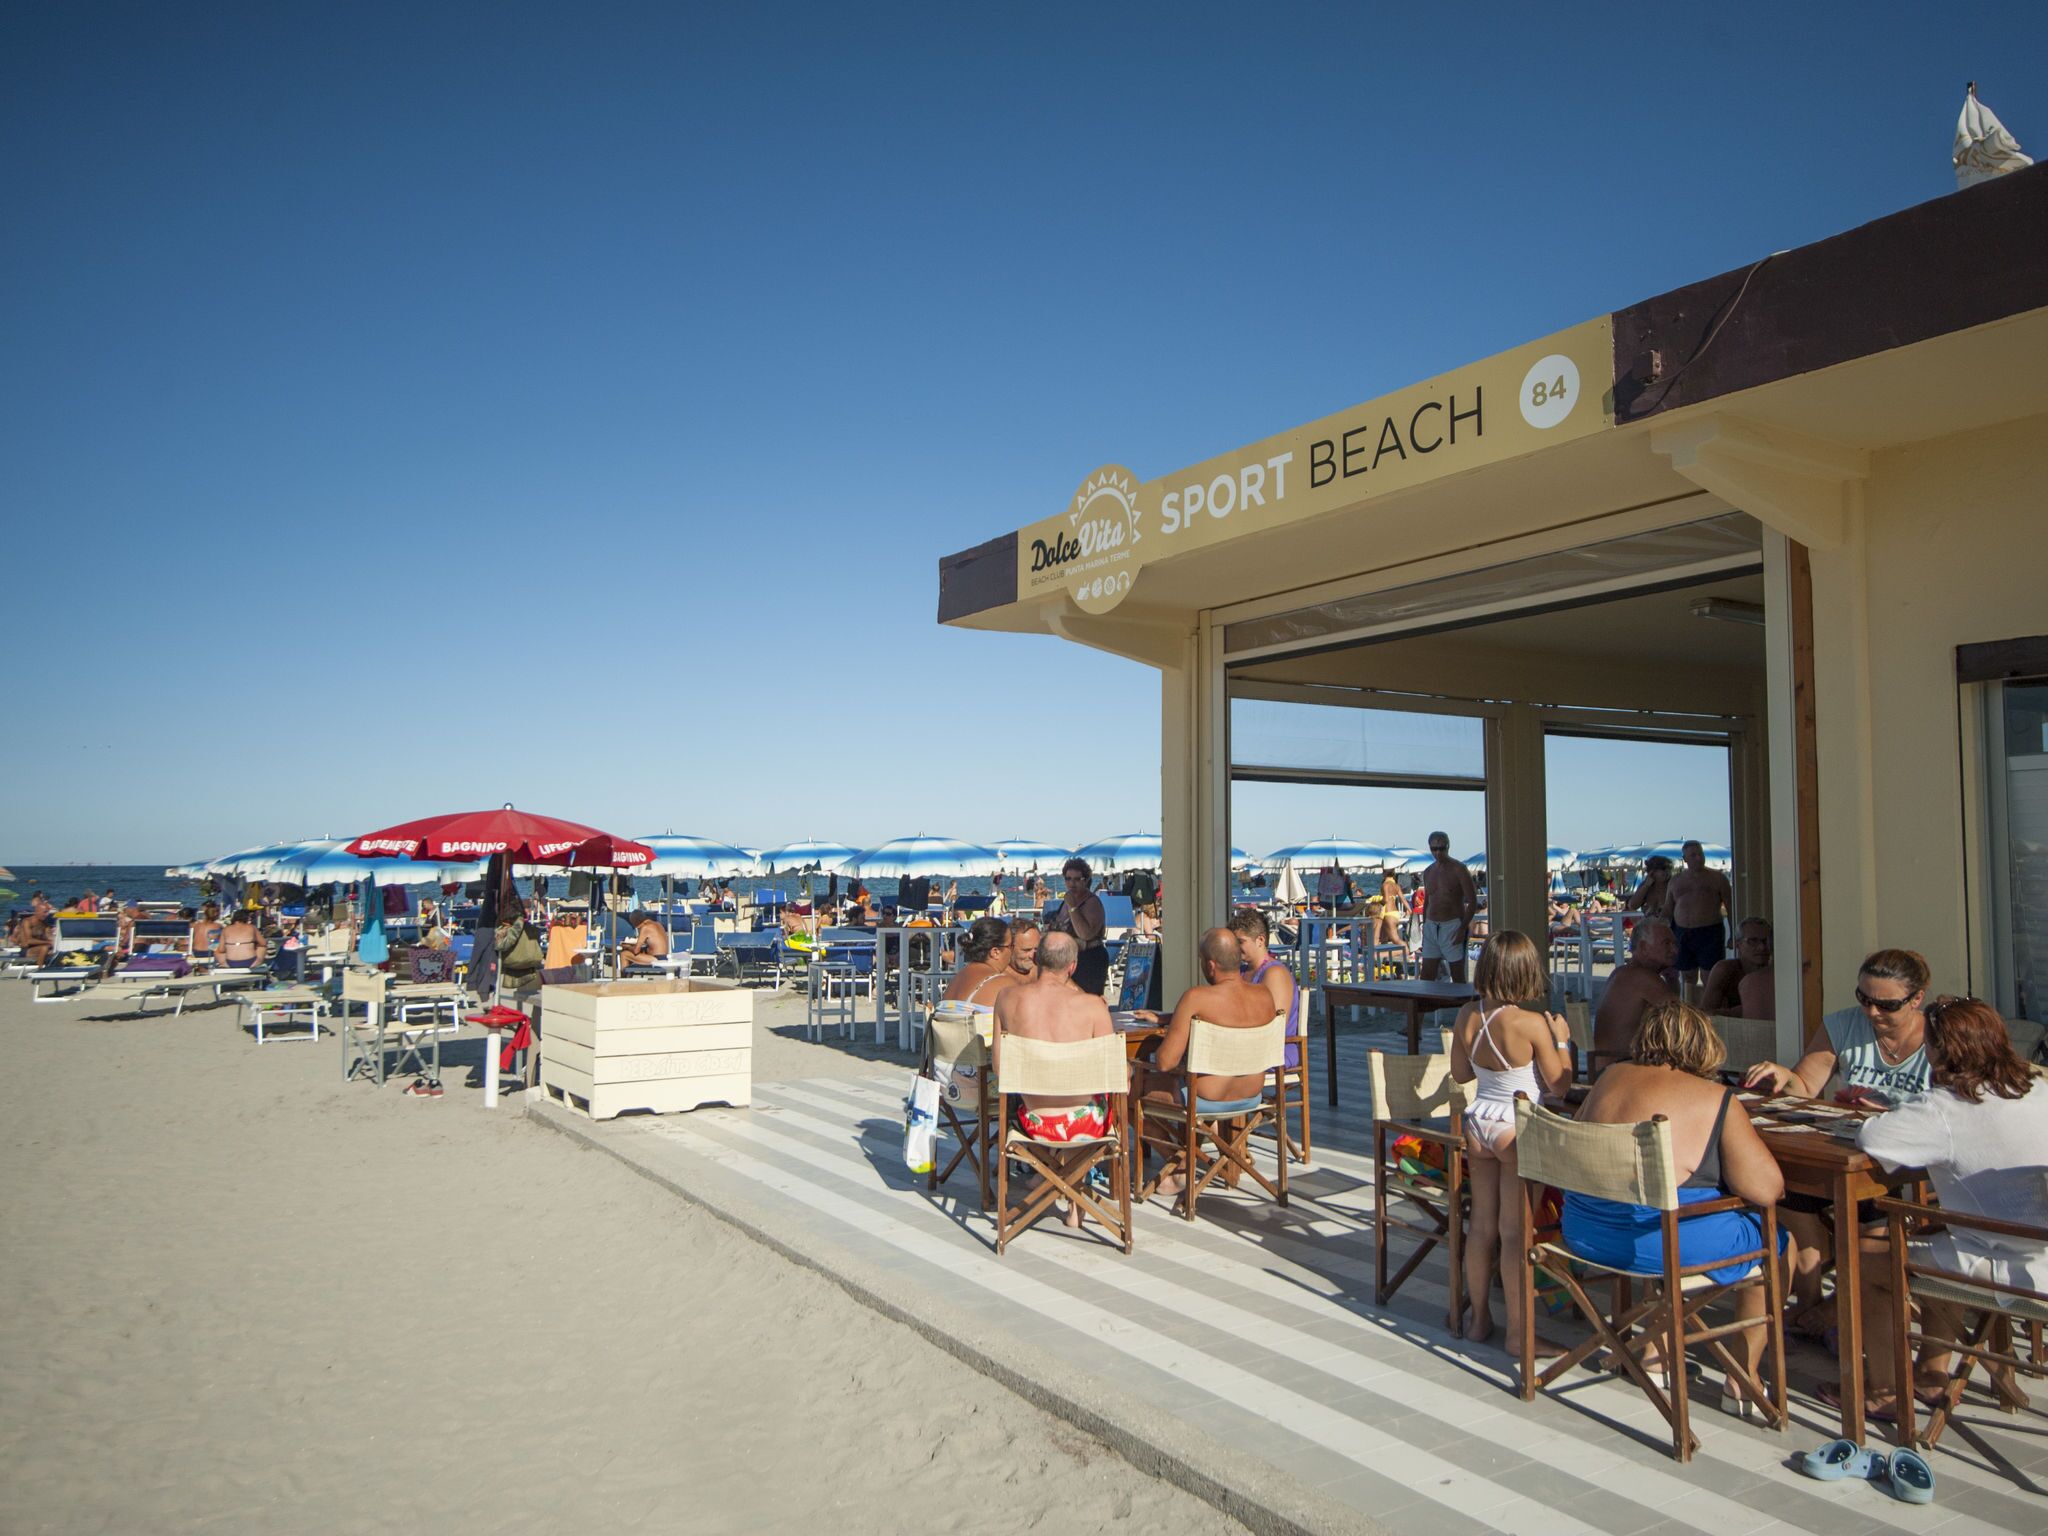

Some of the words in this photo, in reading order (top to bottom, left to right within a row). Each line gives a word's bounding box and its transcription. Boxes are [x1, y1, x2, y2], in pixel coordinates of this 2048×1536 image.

[1531, 374, 1567, 407] 84
[1160, 451, 1293, 535] SPORT
[1310, 386, 1483, 489] BEACH
[1031, 575, 1050, 587] BEACH
[1050, 569, 1065, 581] CLUB
[1065, 563, 1085, 576] PUNTA
[441, 841, 507, 853] BAGNINO
[1848, 1065, 1925, 1094] FITNESS
